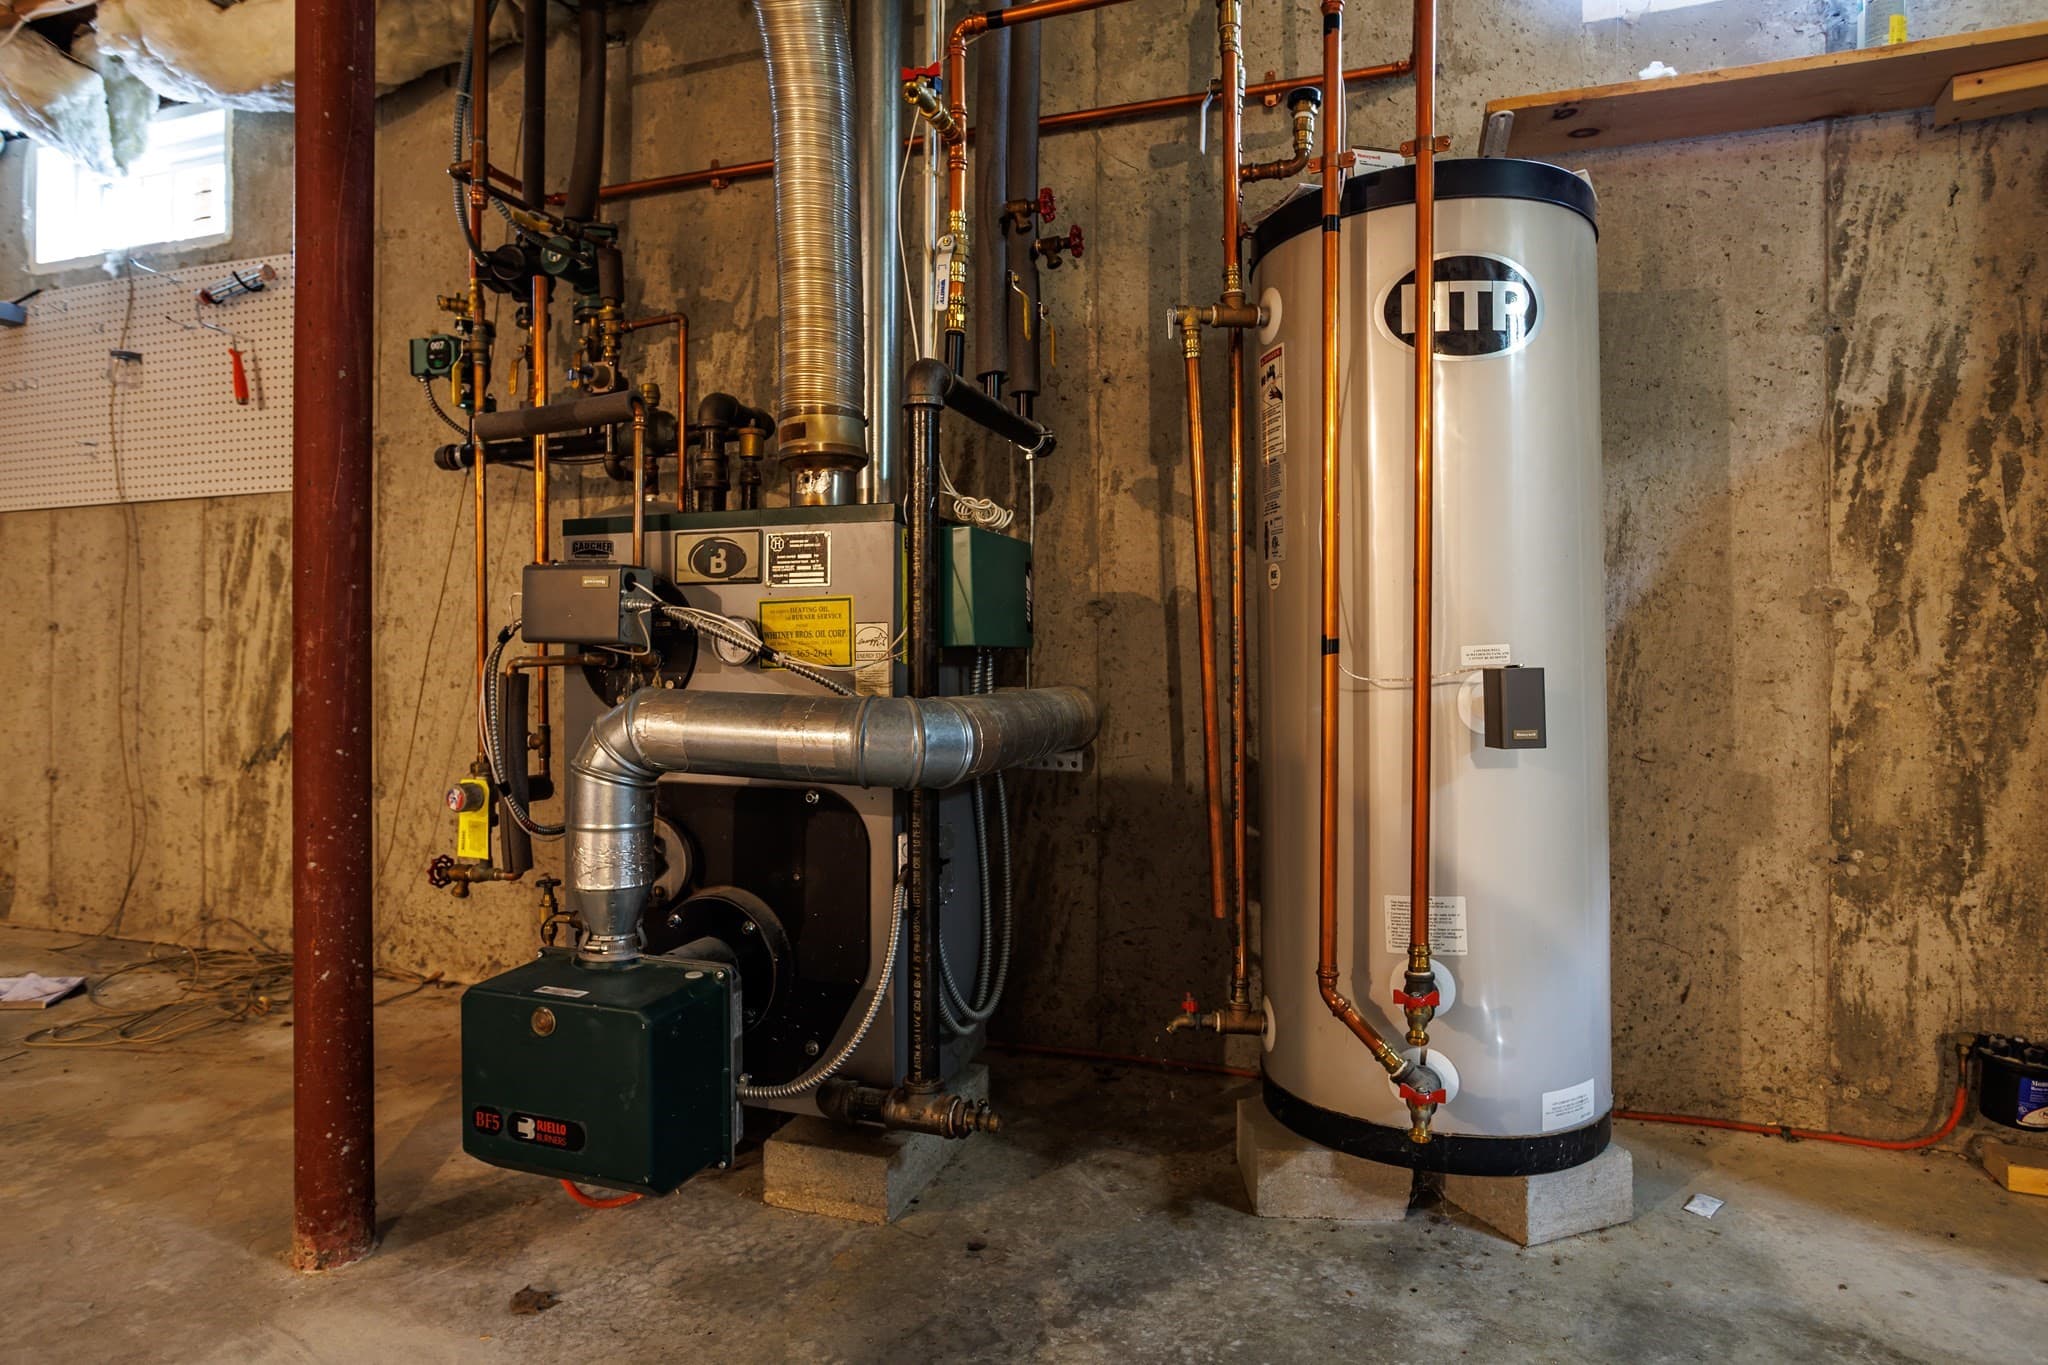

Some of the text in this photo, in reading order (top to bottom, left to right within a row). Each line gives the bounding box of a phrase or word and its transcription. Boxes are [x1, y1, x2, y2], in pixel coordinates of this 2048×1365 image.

[764, 631, 793, 639] WHITNEY
[815, 629, 825, 637] OIL
[475, 1111, 500, 1130] BF5
[536, 1120, 566, 1135] RIELLO
